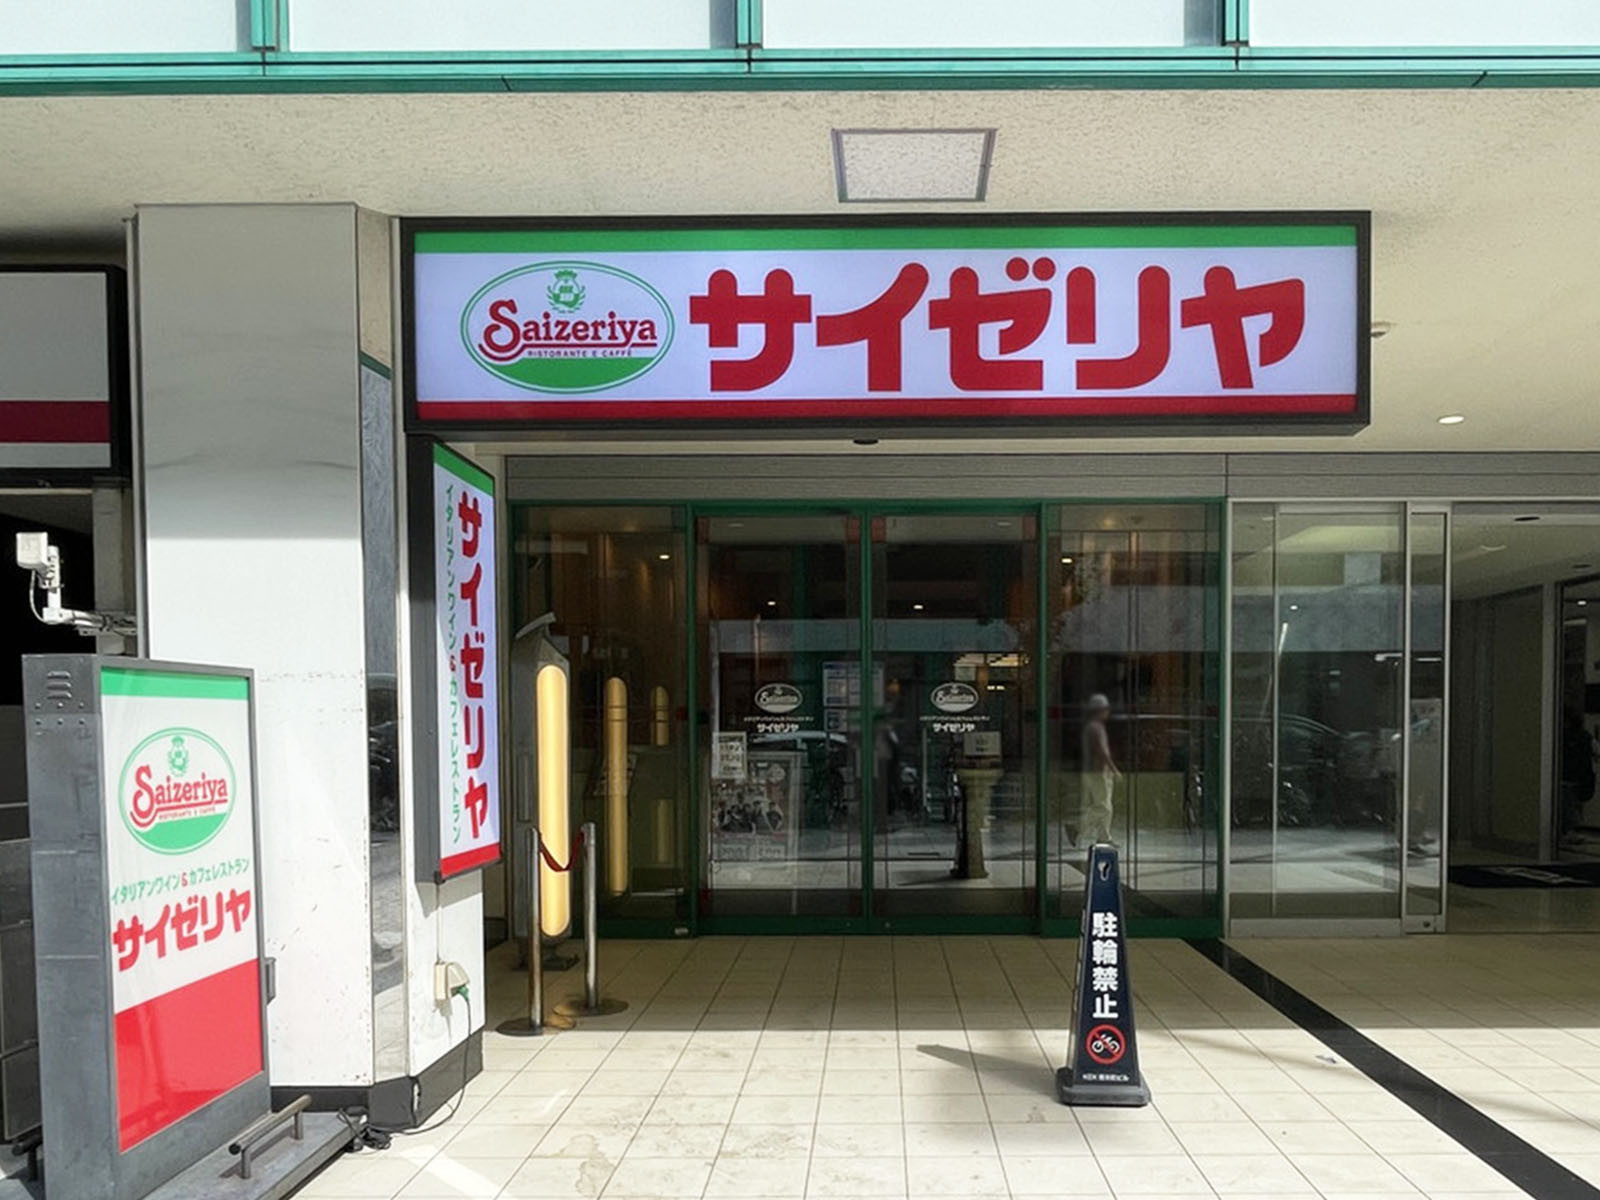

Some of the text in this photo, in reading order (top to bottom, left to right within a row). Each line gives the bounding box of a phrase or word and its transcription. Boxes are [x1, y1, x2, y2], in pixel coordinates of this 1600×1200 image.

[480, 299, 657, 357] Saizeriya
[527, 349, 587, 358] RISTORANTE
[591, 349, 598, 357] E
[690, 258, 1305, 393] サイゼリヤ
[458, 490, 489, 840] サイゼリヤ
[131, 764, 229, 827] Saizeriya
[111, 858, 250, 905] イタリアンワイン&カフェレストラン
[113, 888, 252, 972] サイゼリヤ
[1092, 911, 1119, 1019] 駐輪禁止
